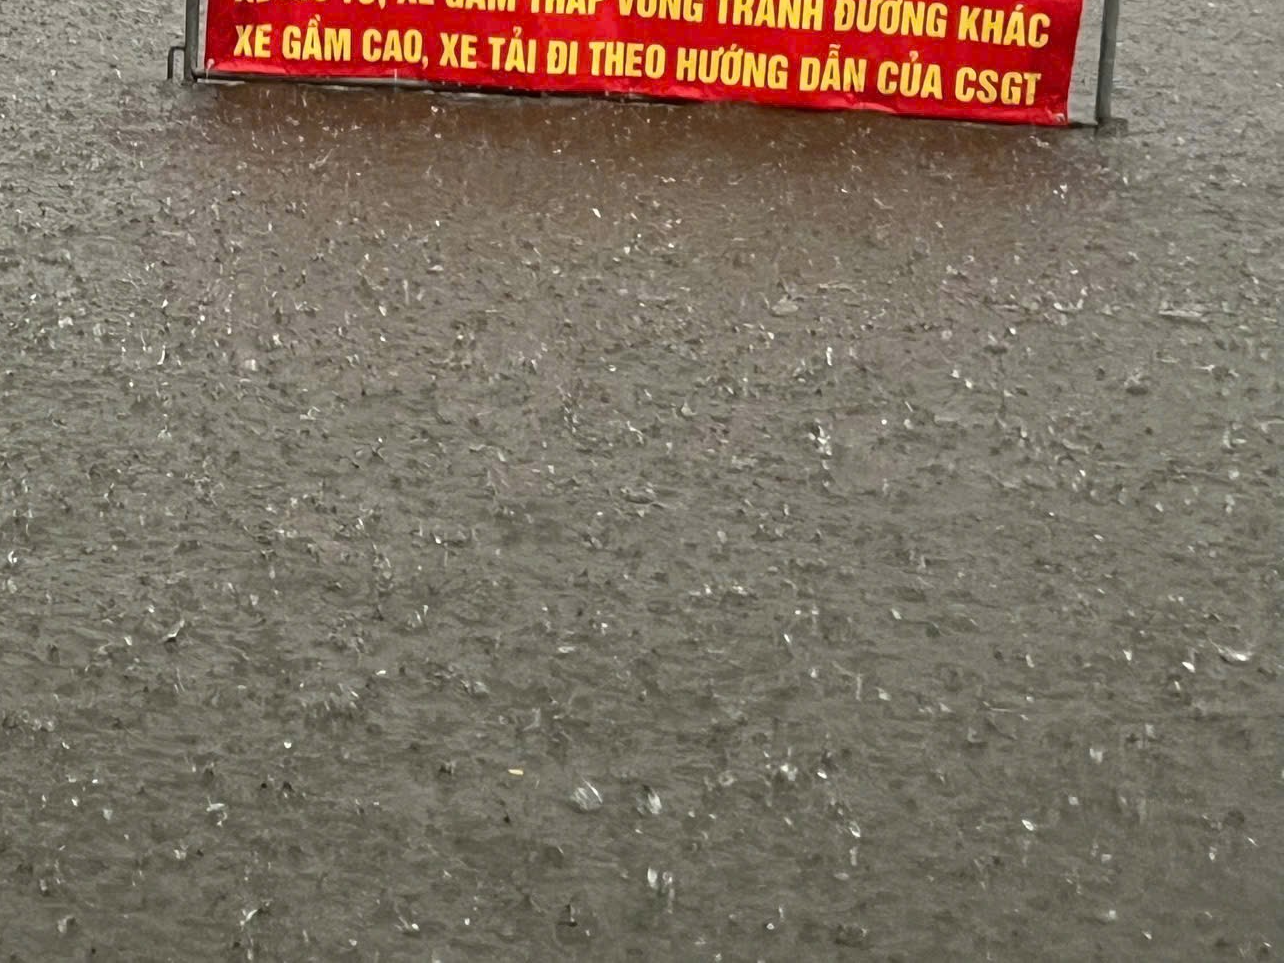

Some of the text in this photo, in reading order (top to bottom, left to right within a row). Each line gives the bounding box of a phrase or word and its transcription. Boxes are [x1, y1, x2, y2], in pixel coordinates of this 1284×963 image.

[233, 14, 1042, 106] XE GẦM CAO, XE TẢI ĐI THEO HƯỚNG DẪN CỦA CSGT
[957, 4, 1051, 49] KHÁC
